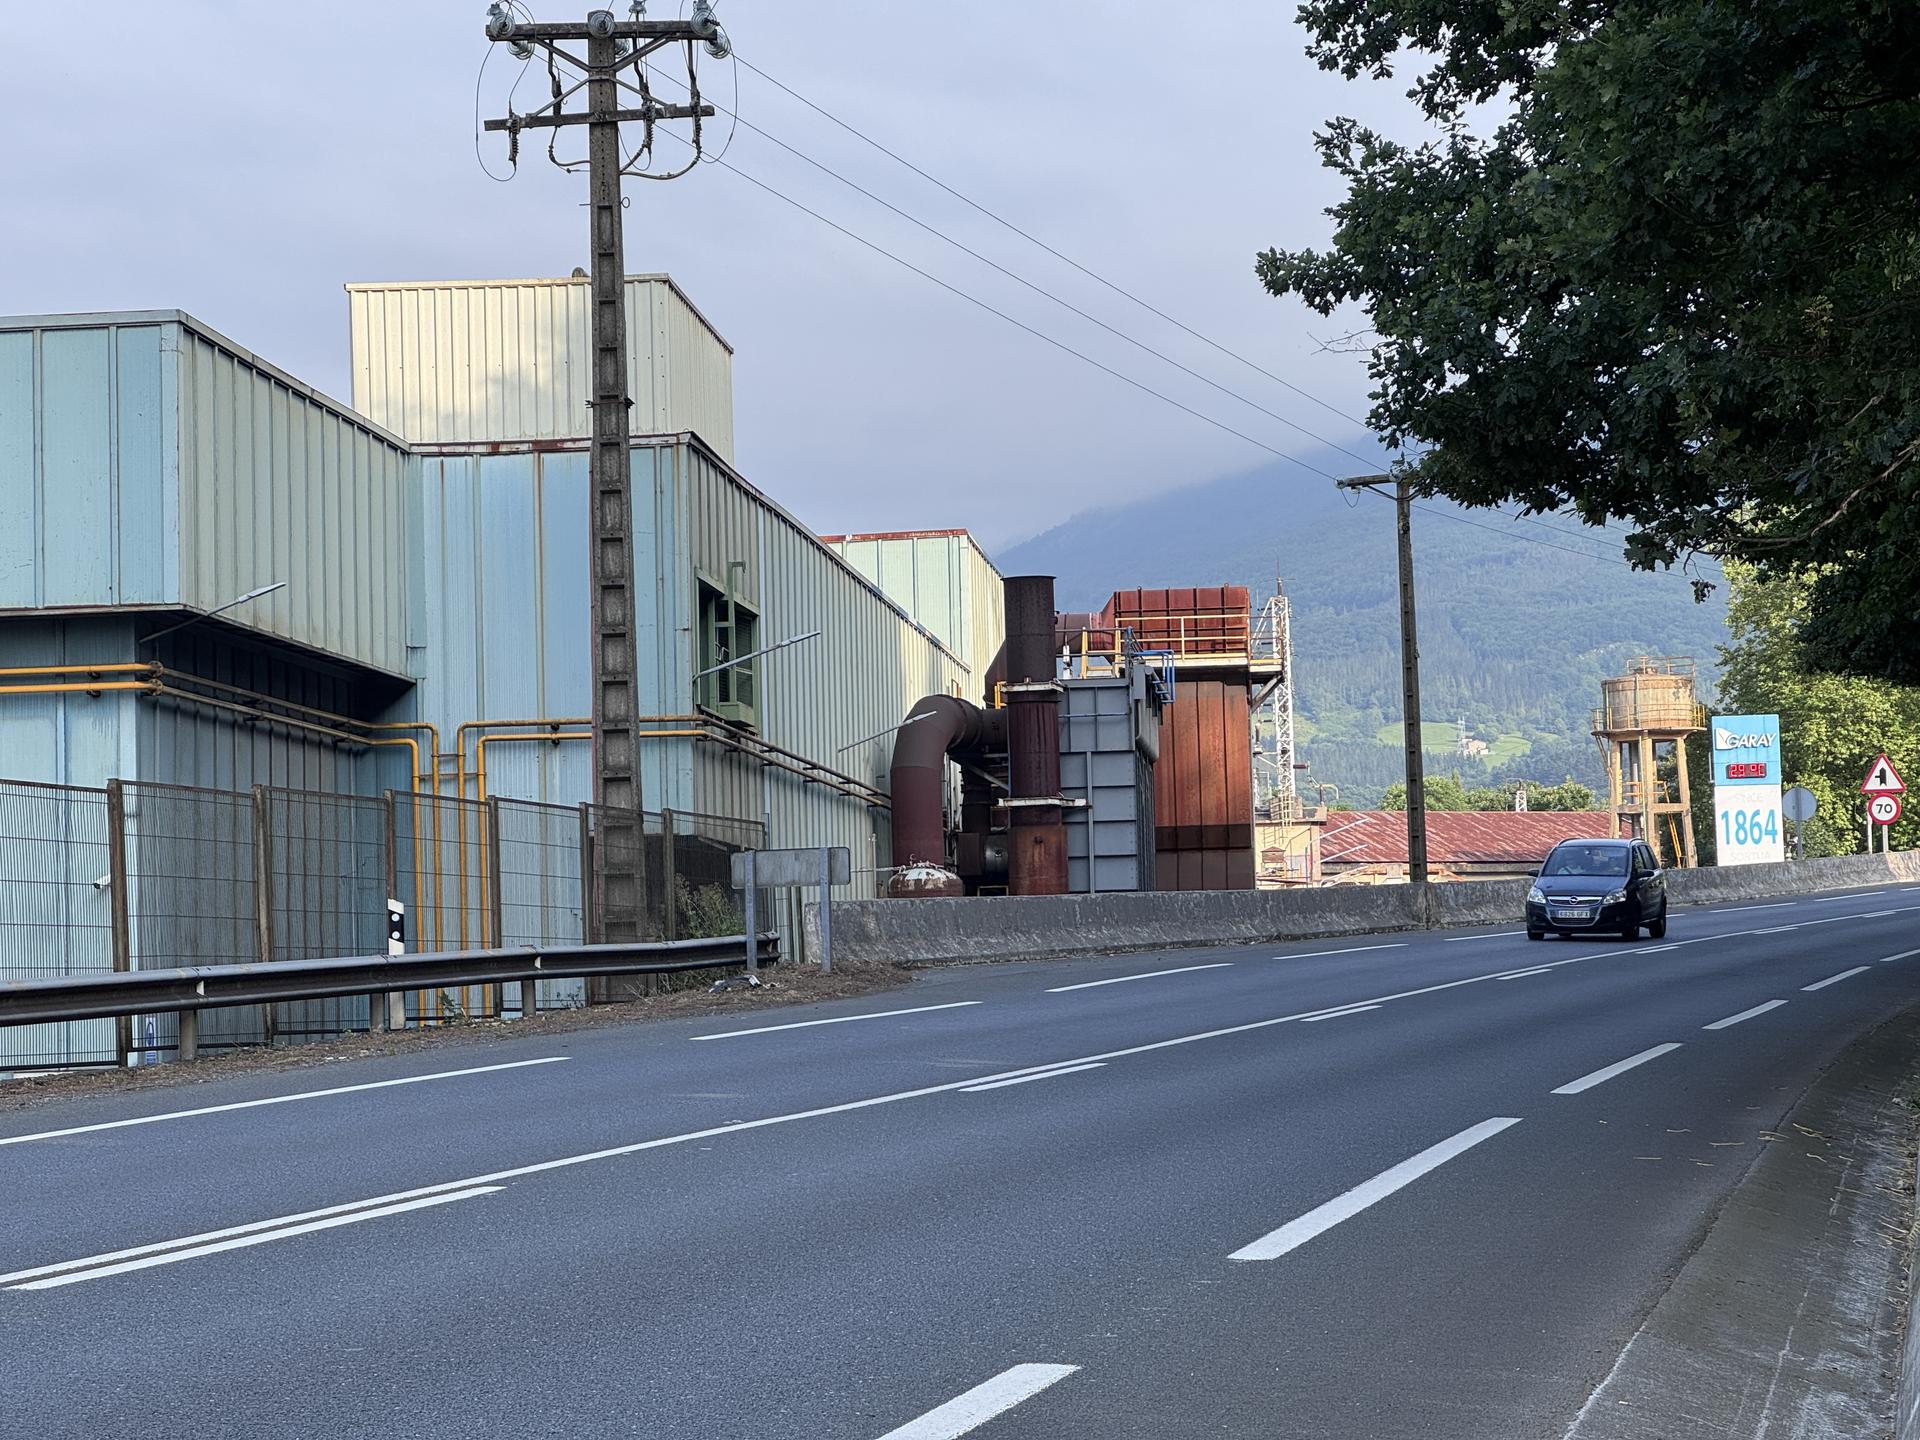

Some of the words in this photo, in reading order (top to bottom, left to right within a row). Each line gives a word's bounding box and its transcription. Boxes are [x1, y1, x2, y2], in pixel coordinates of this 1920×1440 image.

[1726, 733, 1777, 749] GARAY
[1730, 764, 1746, 778] 29
[1875, 803, 1893, 814] 70
[1721, 809, 1778, 846] 1864
